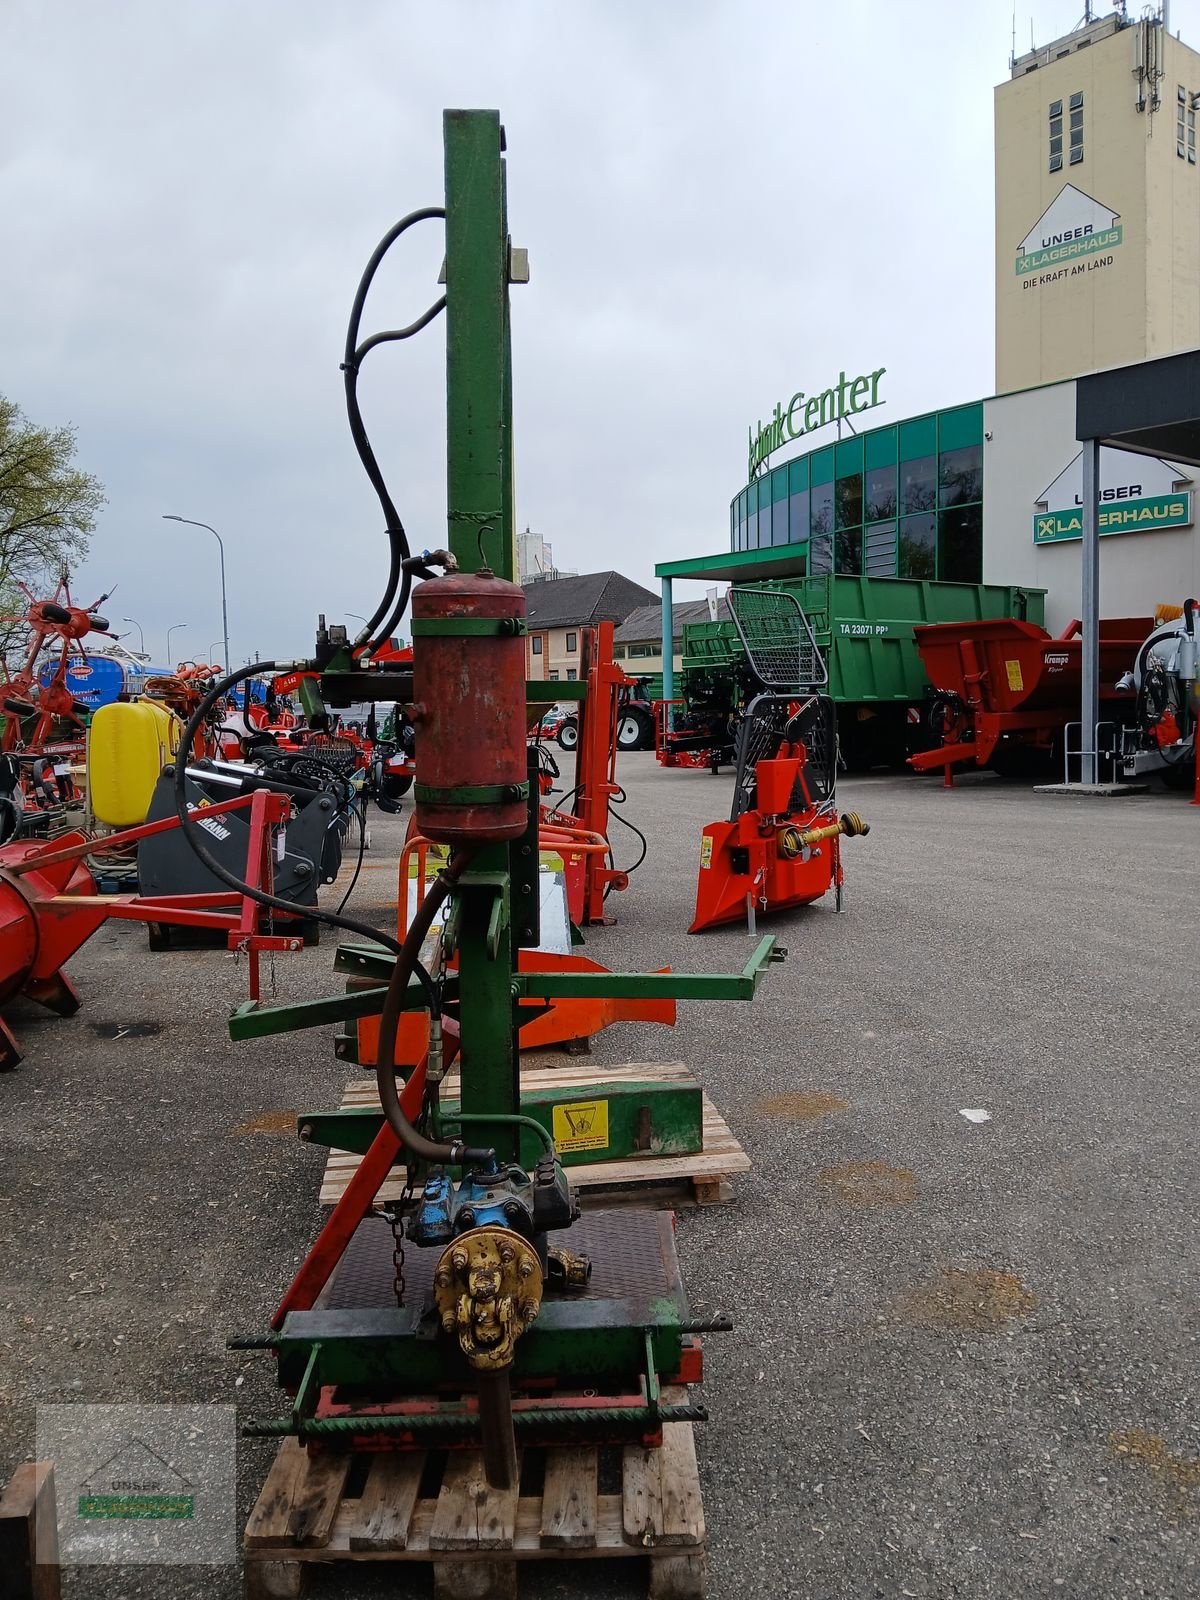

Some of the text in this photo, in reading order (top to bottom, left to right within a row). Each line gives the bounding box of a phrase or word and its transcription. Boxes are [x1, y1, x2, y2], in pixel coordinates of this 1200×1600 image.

[1042, 224, 1093, 248] UNSER
[1032, 231, 1119, 266] LAGERHAUS
[1023, 255, 1114, 289] DIE KRAFT AM LAND
[1075, 484, 1142, 505] USER
[1057, 503, 1184, 532] LAERHAUS
[840, 624, 850, 634] TA
[852, 624, 873, 634] 23071
[1044, 653, 1069, 665] Krampe
